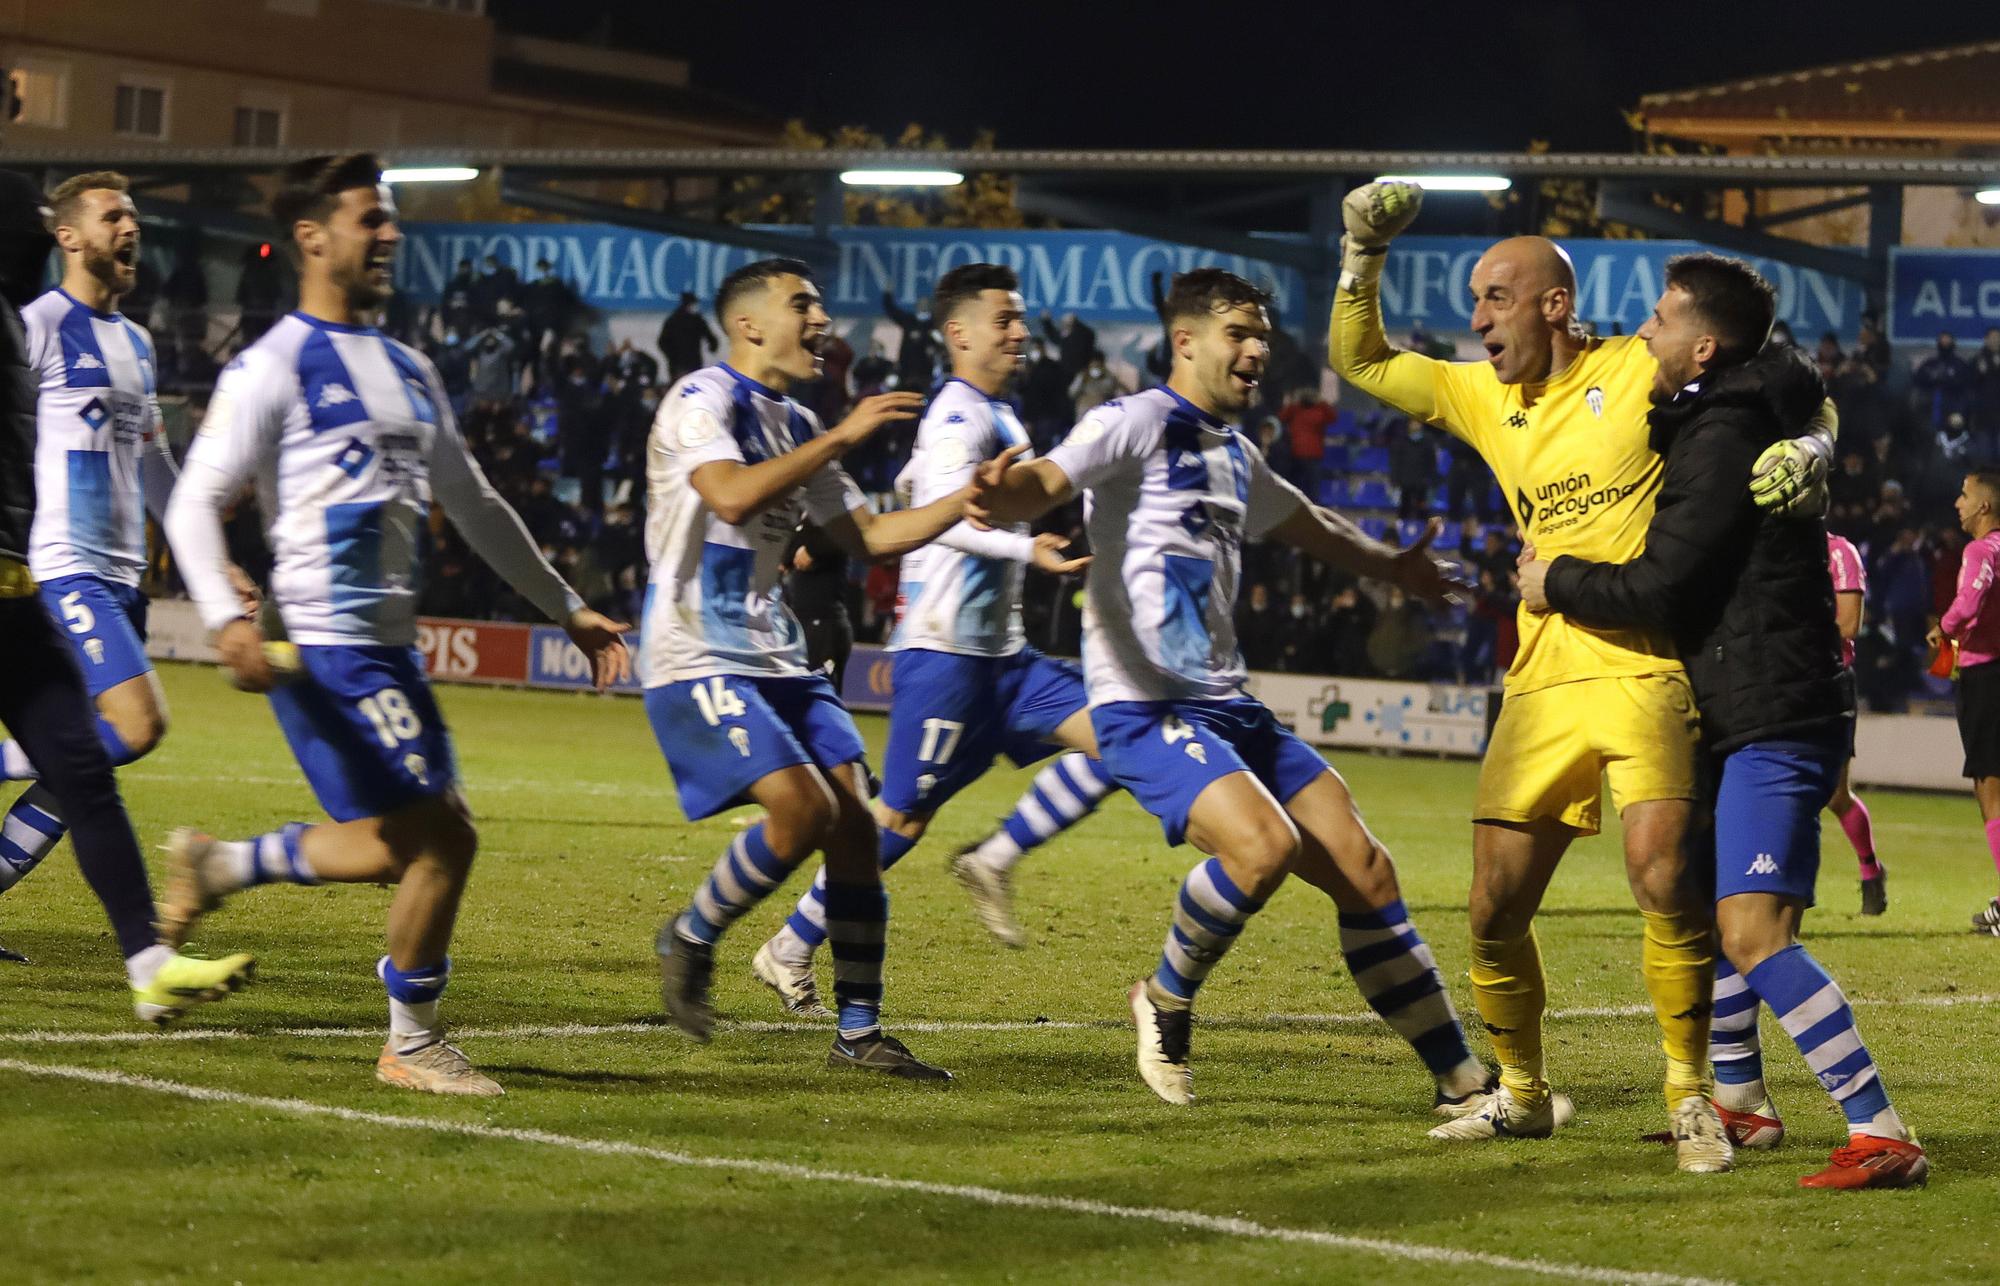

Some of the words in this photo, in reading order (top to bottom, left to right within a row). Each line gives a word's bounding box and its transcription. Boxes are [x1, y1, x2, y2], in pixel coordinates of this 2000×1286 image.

[1535, 472, 1591, 501] unión
[58, 590, 96, 634] 5
[357, 688, 422, 749] 18
[690, 676, 747, 727] 14
[917, 717, 965, 765] 17
[1161, 714, 1196, 746] 4
